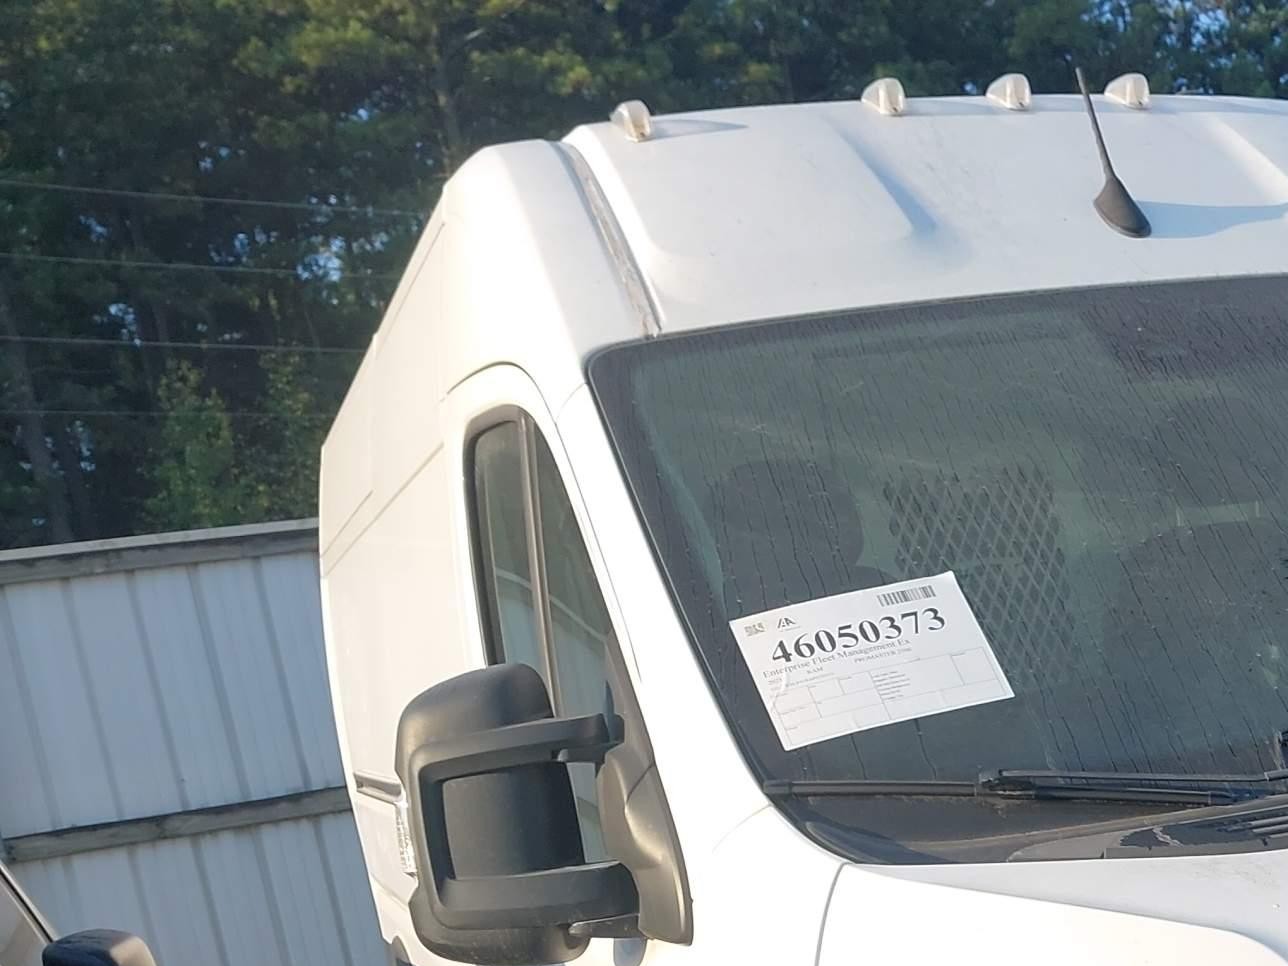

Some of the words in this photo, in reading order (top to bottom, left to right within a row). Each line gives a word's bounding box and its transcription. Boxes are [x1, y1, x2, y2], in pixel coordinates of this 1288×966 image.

[771, 606, 945, 664] 46050373
[763, 660, 811, 678] Enterprise
[812, 654, 836, 666] Fleet
[837, 641, 896, 659] Management
